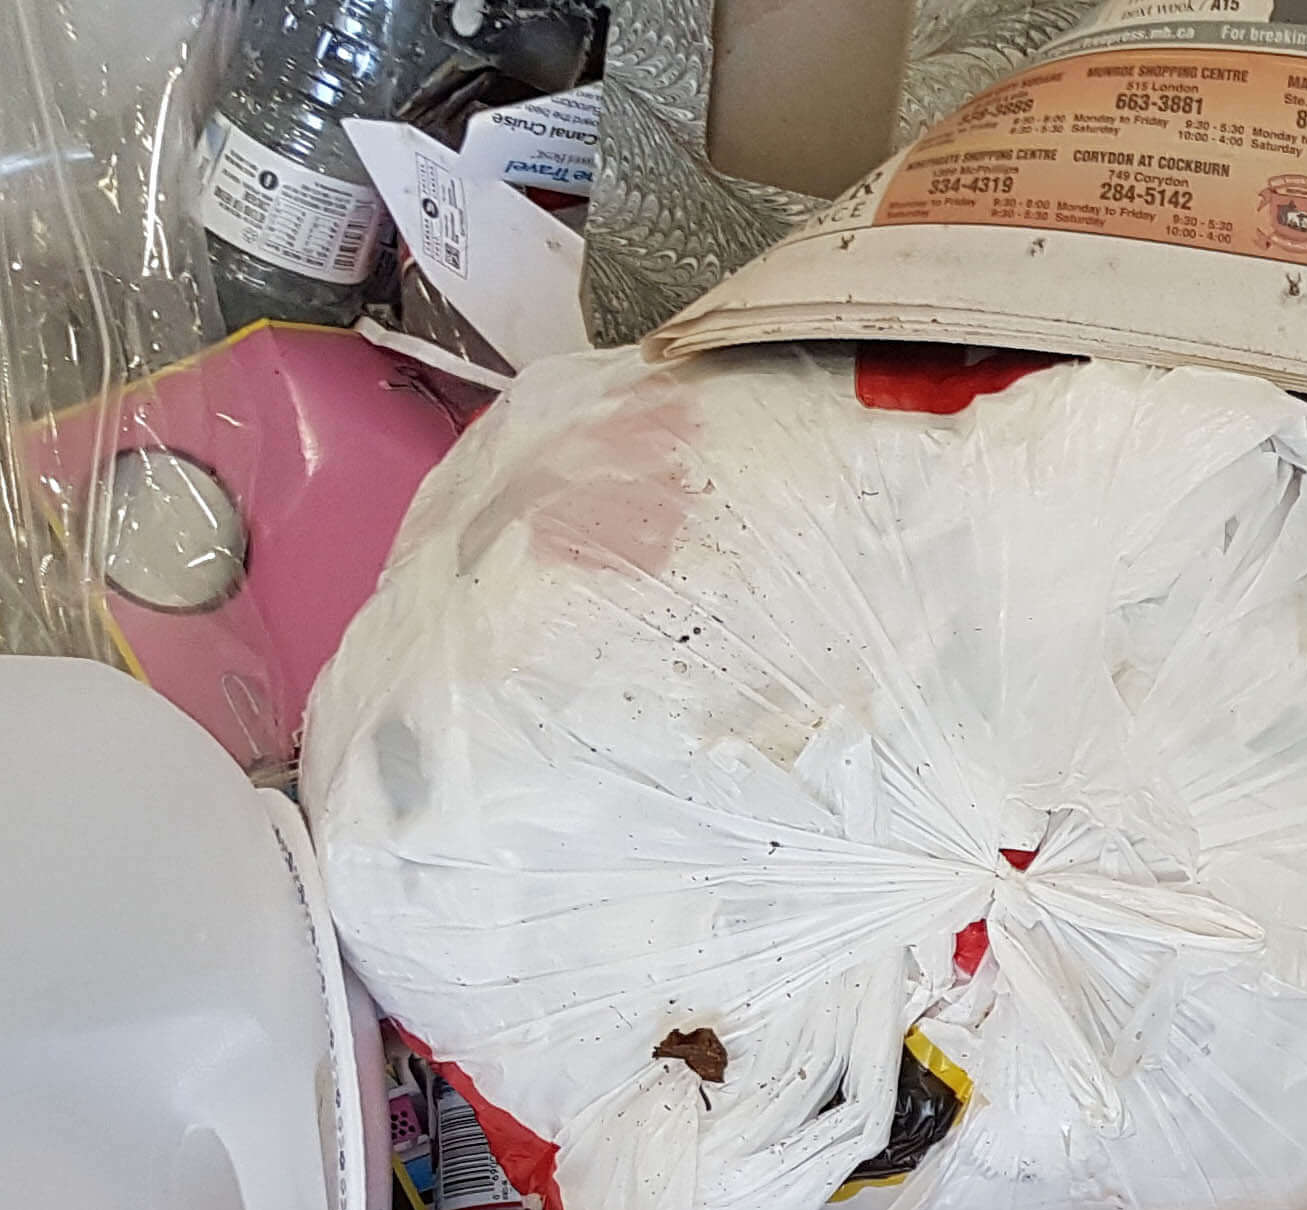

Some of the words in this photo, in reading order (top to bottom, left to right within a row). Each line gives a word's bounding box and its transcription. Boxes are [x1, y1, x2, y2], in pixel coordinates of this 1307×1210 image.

[1221, 25, 1245, 41] For
[1202, 62, 1249, 82] CENTRE
[1151, 83, 1200, 94] London
[1115, 94, 1204, 115] 663-3881
[491, 112, 547, 136] Cruise
[1073, 150, 1135, 166] CORYDON
[1138, 155, 1154, 168] AT
[1158, 156, 1232, 178] COCKBURN
[1100, 183, 1194, 210] 284-5142
